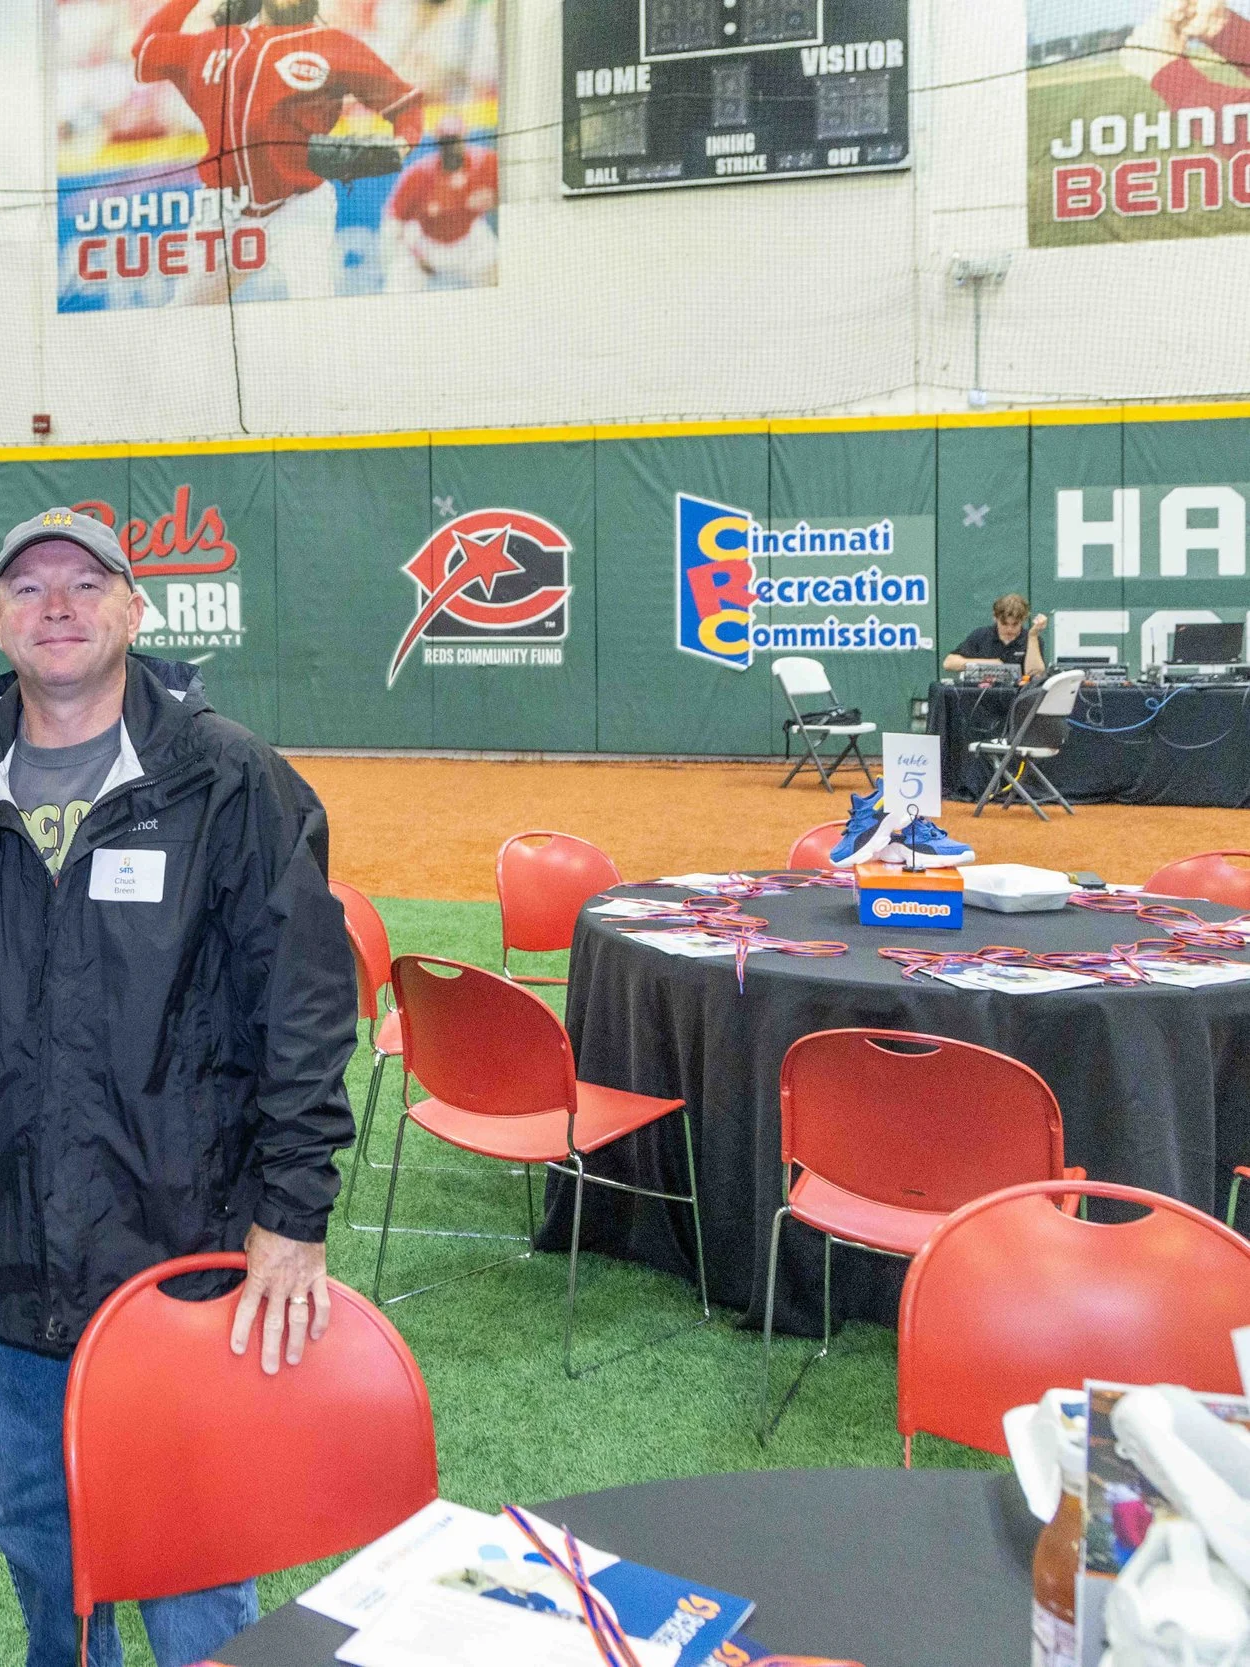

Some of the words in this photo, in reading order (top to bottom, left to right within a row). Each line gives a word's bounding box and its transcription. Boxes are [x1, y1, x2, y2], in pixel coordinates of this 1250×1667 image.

[801, 39, 904, 76] VISITOR
[576, 64, 651, 98] HOME
[706, 132, 755, 157] INNING
[1051, 103, 1250, 159] JOHNN
[715, 154, 767, 175] STRIKE
[827, 147, 860, 166] OUT
[585, 167, 619, 186] BALL
[76, 185, 248, 231] JOHNNY
[78, 226, 267, 281] CUETO
[698, 516, 891, 562] Cincinnati
[1057, 486, 1246, 578] HA
[166, 582, 241, 632] RBI
[687, 559, 926, 620] Recreation
[698, 609, 918, 655] Commission
[424, 648, 454, 664] REDS
[456, 648, 528, 665] COMMUNITY
[530, 648, 562, 664] FUND
[898, 754, 927, 766] table
[899, 771, 927, 799] 5
[872, 898, 950, 918] @ntilopa
